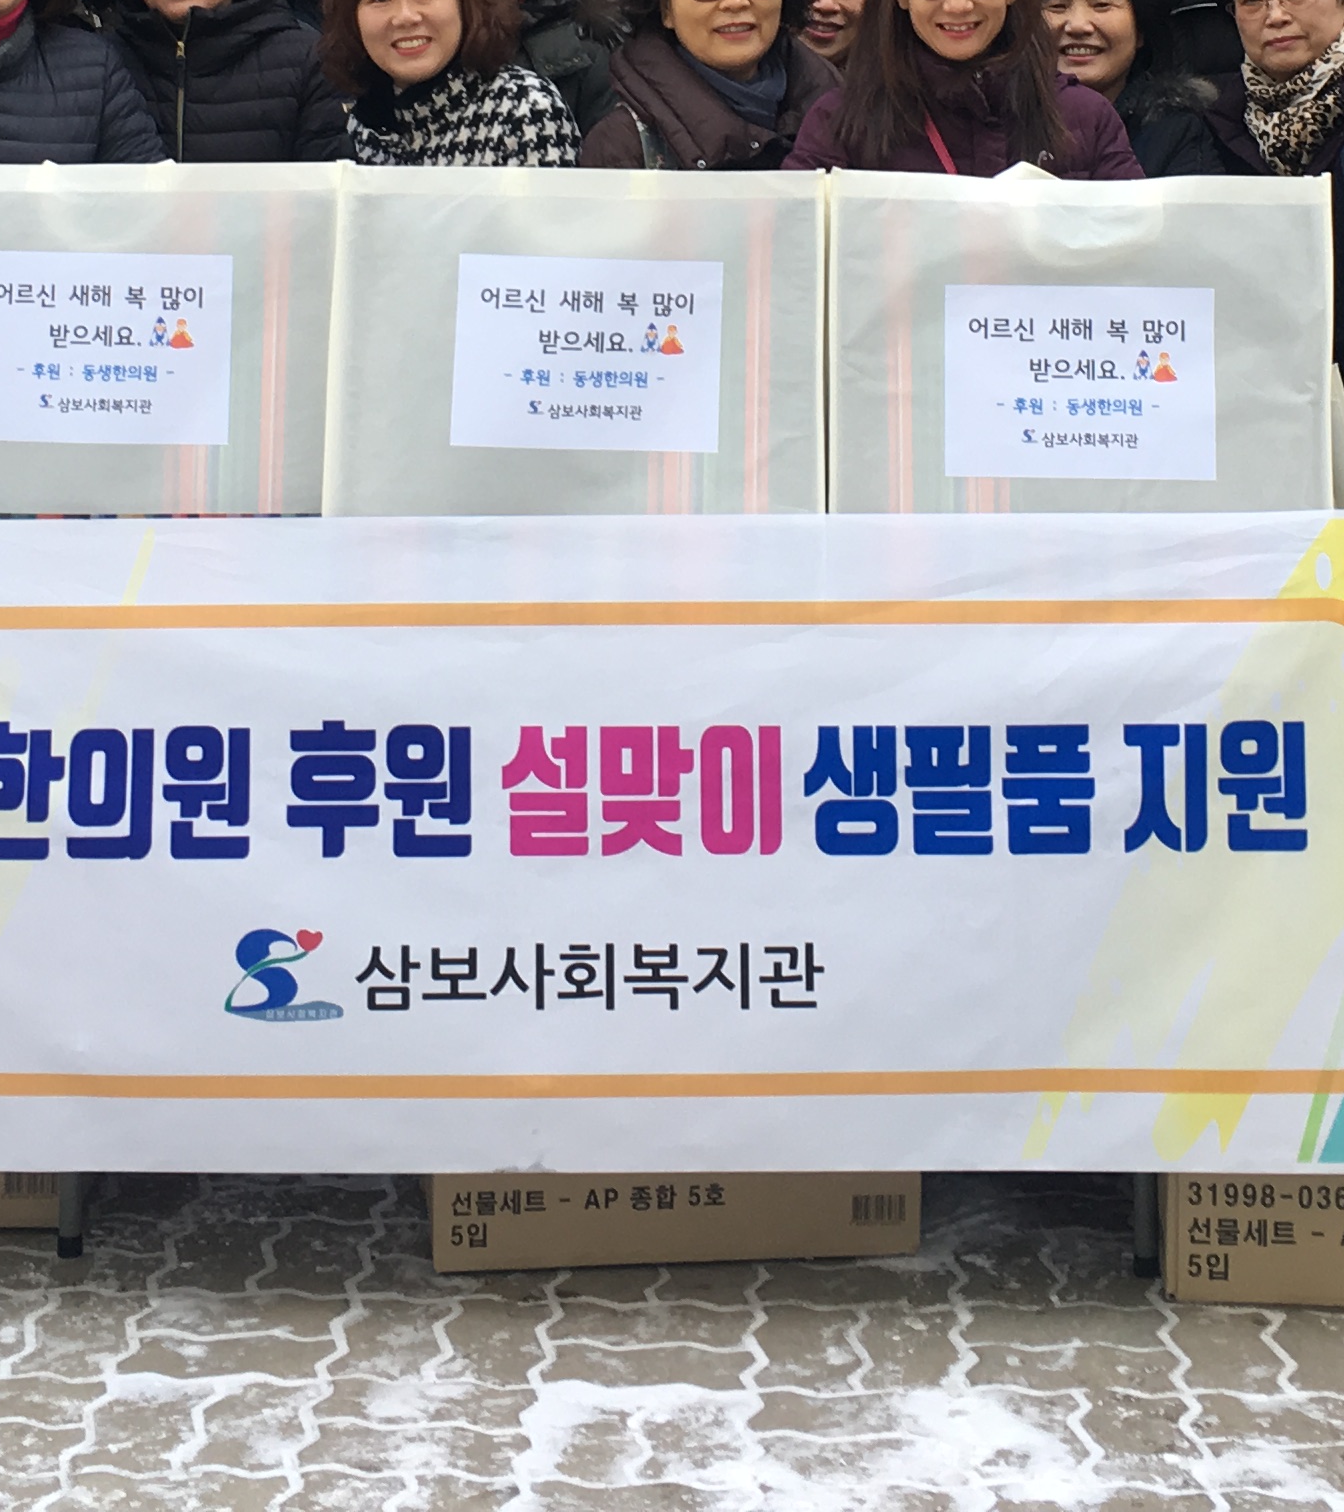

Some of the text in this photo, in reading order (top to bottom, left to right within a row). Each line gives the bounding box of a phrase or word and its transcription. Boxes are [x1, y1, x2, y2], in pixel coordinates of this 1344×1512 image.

[69, 284, 112, 307] 새해
[125, 286, 147, 310] 복
[160, 286, 204, 310] 많이
[481, 287, 695, 317] 어르신 새해 복 많이
[49, 324, 142, 348] 받으세요.
[539, 329, 633, 355] 받으세요.
[968, 317, 1186, 344] 어르신 새해 복 많이
[31, 362, 61, 380] 후원
[82, 364, 158, 382] 동생한의원
[520, 368, 551, 386] 후원
[573, 371, 649, 388] 동생한의원
[1029, 358, 1125, 383] 받으세요.
[57, 397, 152, 414] 삼보사회복지관
[548, 404, 642, 420] 삼보사회복지관
[1013, 397, 1043, 415] 후원
[1066, 399, 1143, 416] 동생한의원
[1042, 432, 1139, 449] 삼보사회복지관
[286, 719, 472, 860] 후원
[501, 725, 783, 857] 설맞이
[804, 723, 1095, 857] 생필품
[1122, 719, 1309, 854] 지원
[354, 941, 825, 1011] 삼보사회복지관
[451, 1190, 546, 1216] 선물세트
[584, 1188, 619, 1210] AP
[630, 1186, 677, 1211] 종합
[688, 1183, 726, 1208] 5호
[450, 1224, 488, 1248] 5입
[1188, 1216, 1297, 1247] 선물세트
[1188, 1253, 1230, 1281] 5입
